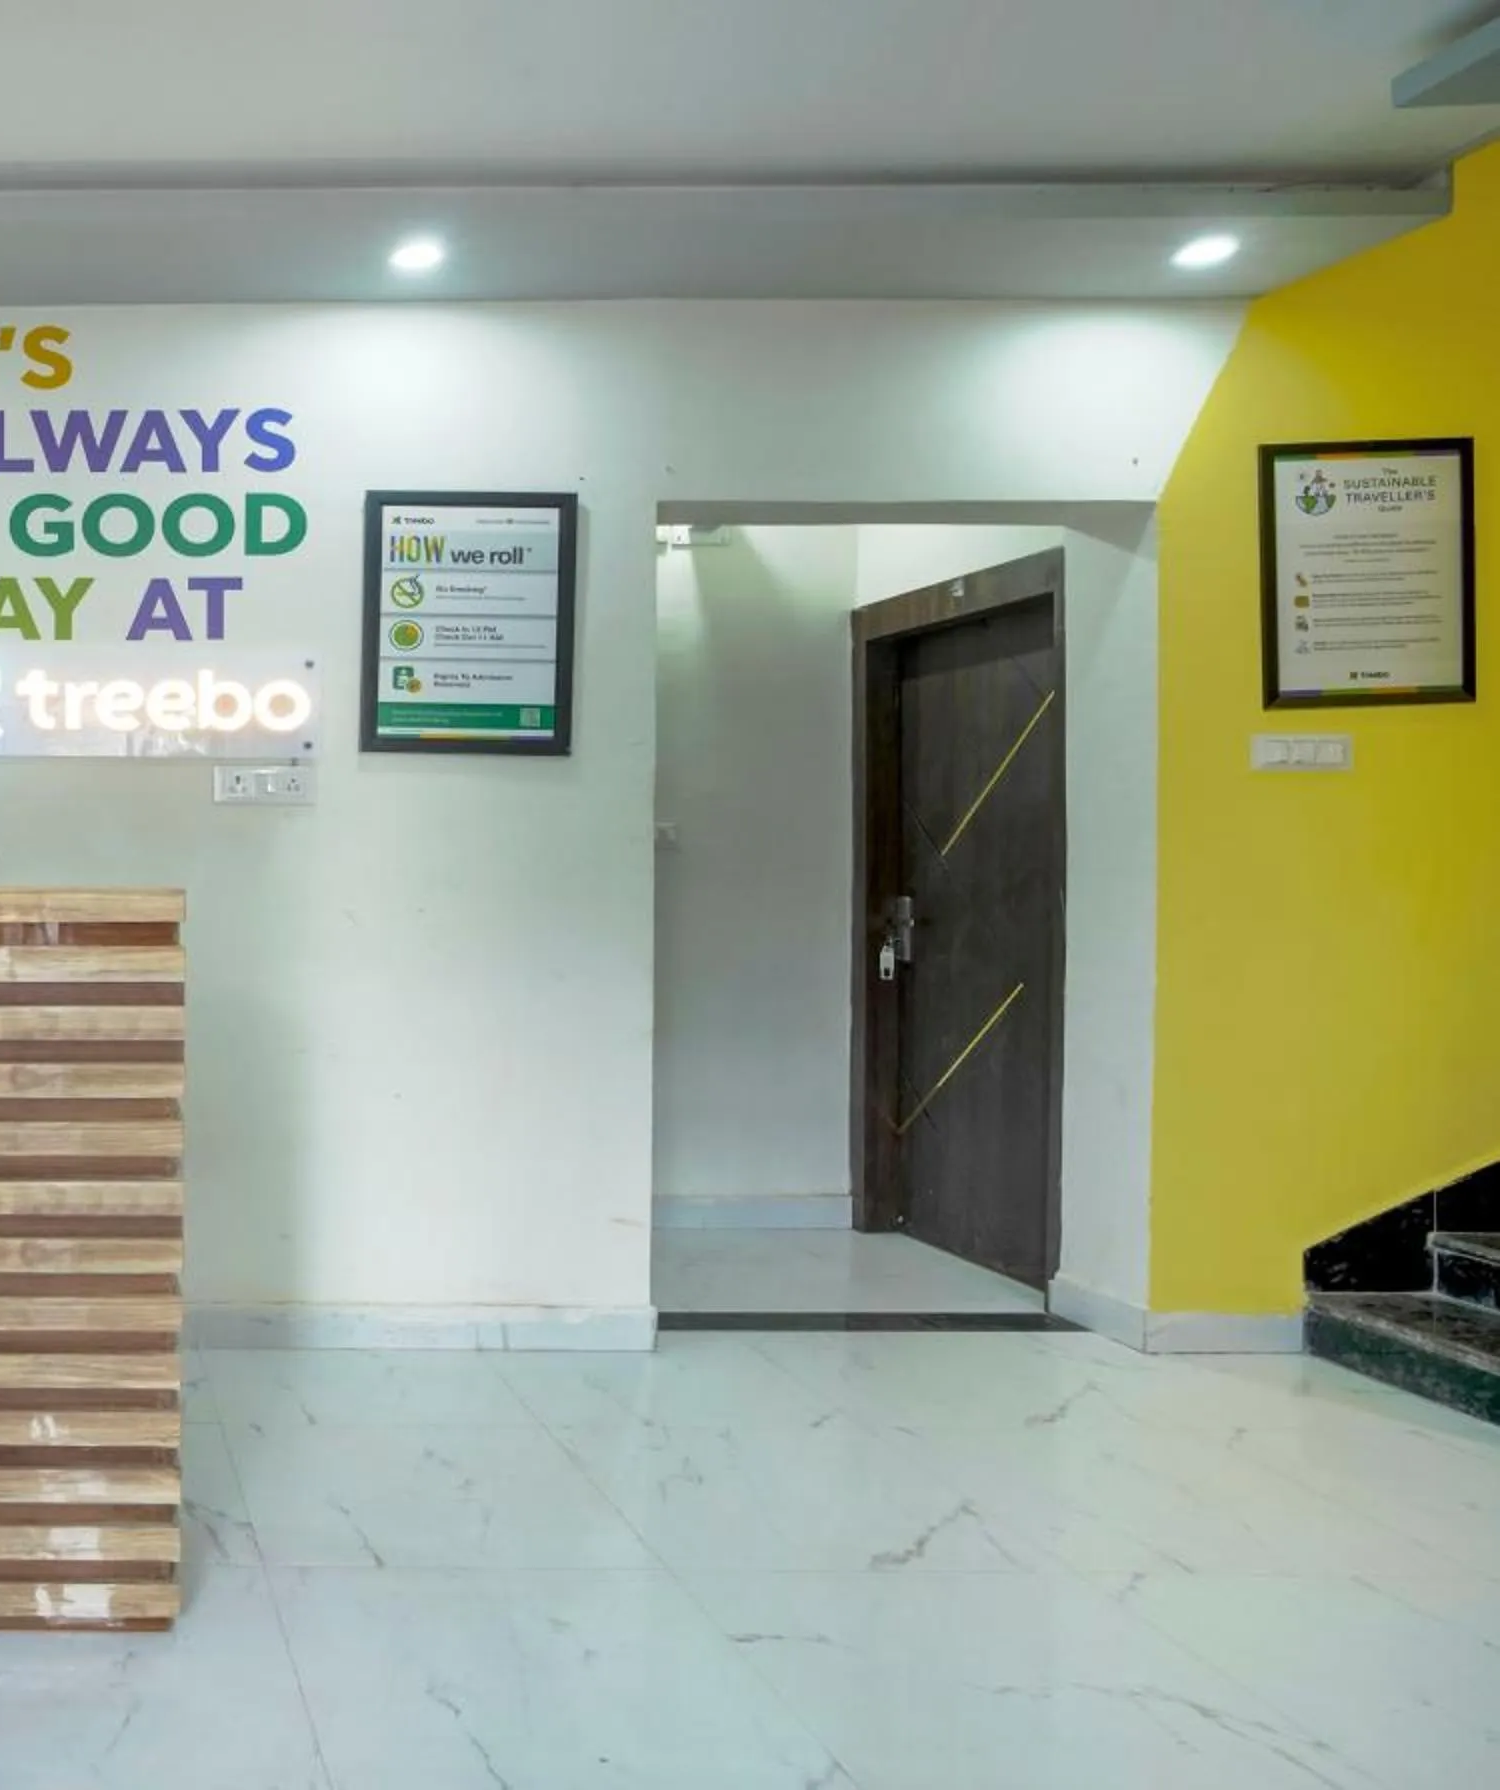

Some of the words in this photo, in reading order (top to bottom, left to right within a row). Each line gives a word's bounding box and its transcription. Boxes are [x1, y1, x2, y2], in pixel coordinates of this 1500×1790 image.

[1343, 475, 1437, 490] SUSTAINABLE
[9, 492, 308, 557] GOOD
[390, 535, 445, 564] HOW
[451, 550, 484, 564] we
[125, 577, 243, 640] AT
[15, 669, 312, 732] treebo
